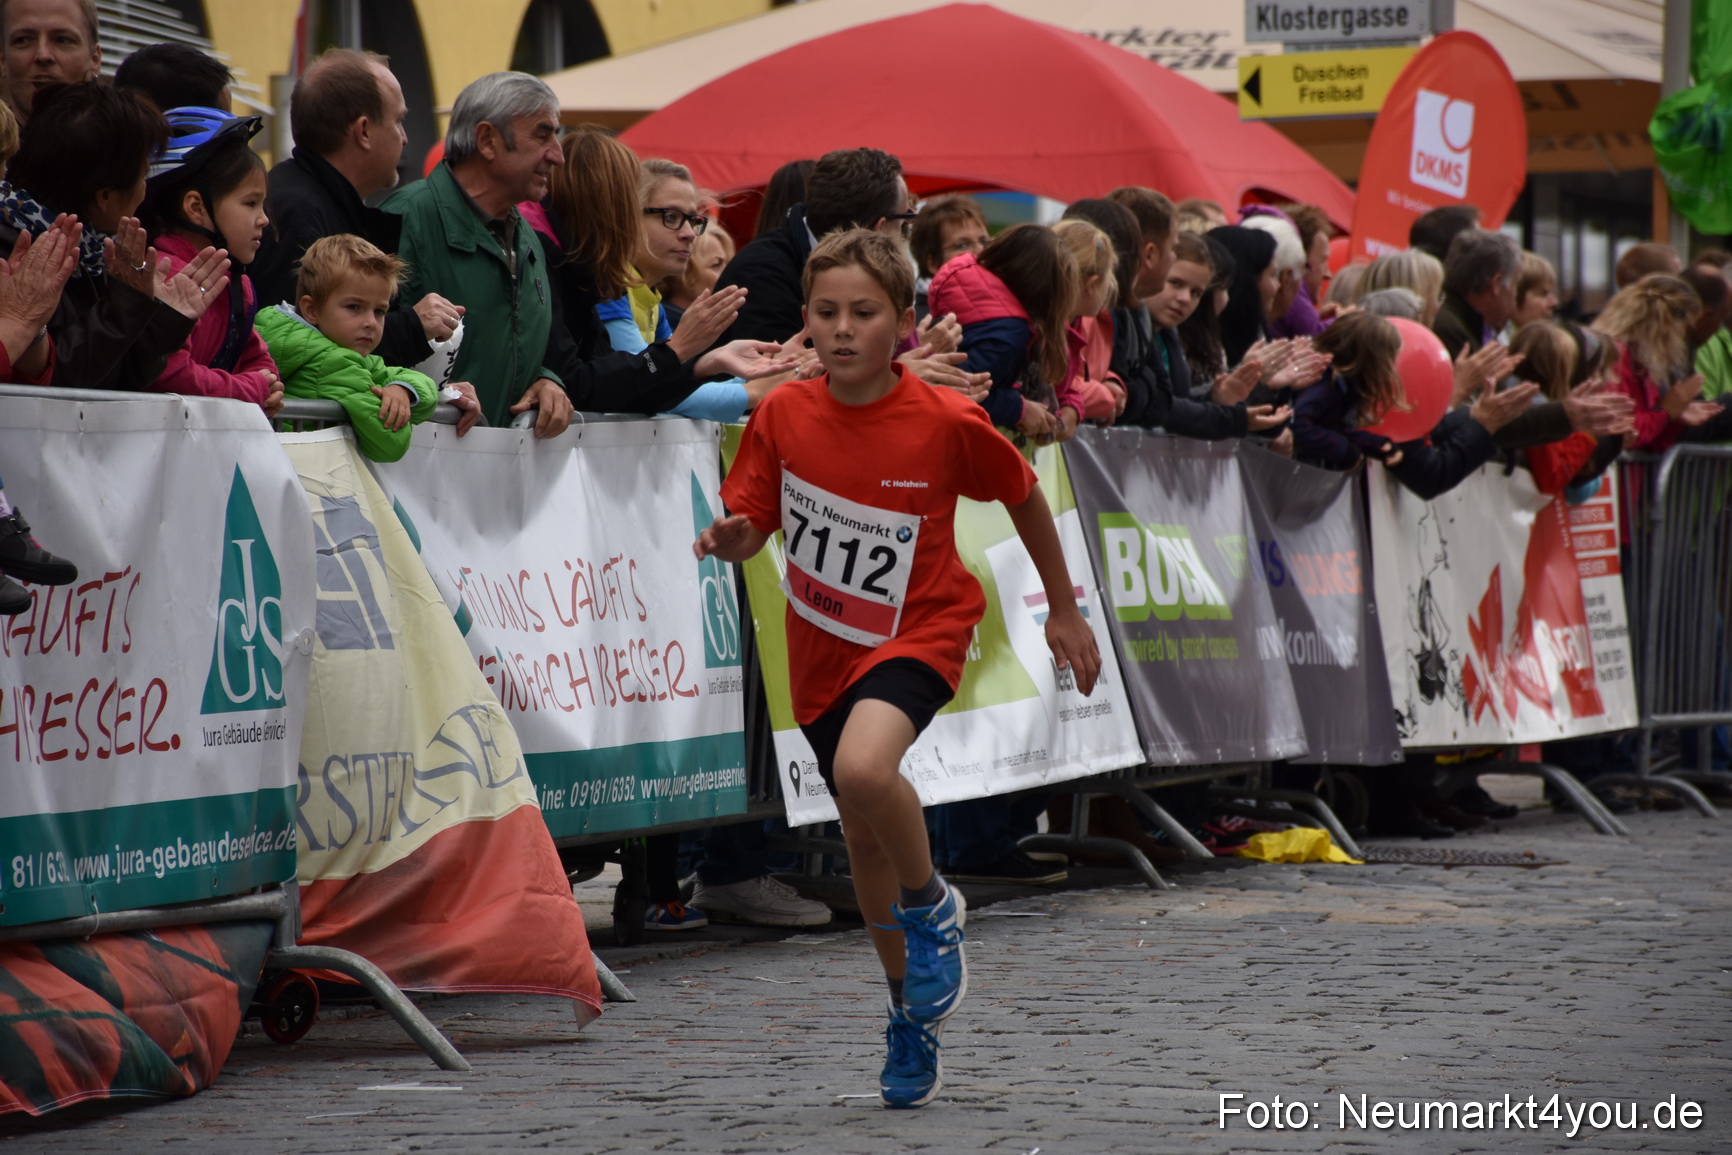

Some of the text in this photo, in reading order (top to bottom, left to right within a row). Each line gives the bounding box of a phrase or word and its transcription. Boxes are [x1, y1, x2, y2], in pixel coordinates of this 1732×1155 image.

[1256, 5, 1409, 35] Klostergasse
[1293, 64, 1369, 84] Duschen
[1299, 85, 1364, 104] Freibad
[1415, 150, 1463, 188] DKMS
[881, 480, 928, 488] FC Holzheim
[784, 482, 819, 514] PARTL
[822, 505, 891, 538] Neumarkt
[789, 507, 898, 597] 7112
[804, 581, 844, 617] Leon
[203, 726, 221, 747] Jura
[222, 722, 262, 745] Gebäude
[804, 782, 830, 797] Neuma
